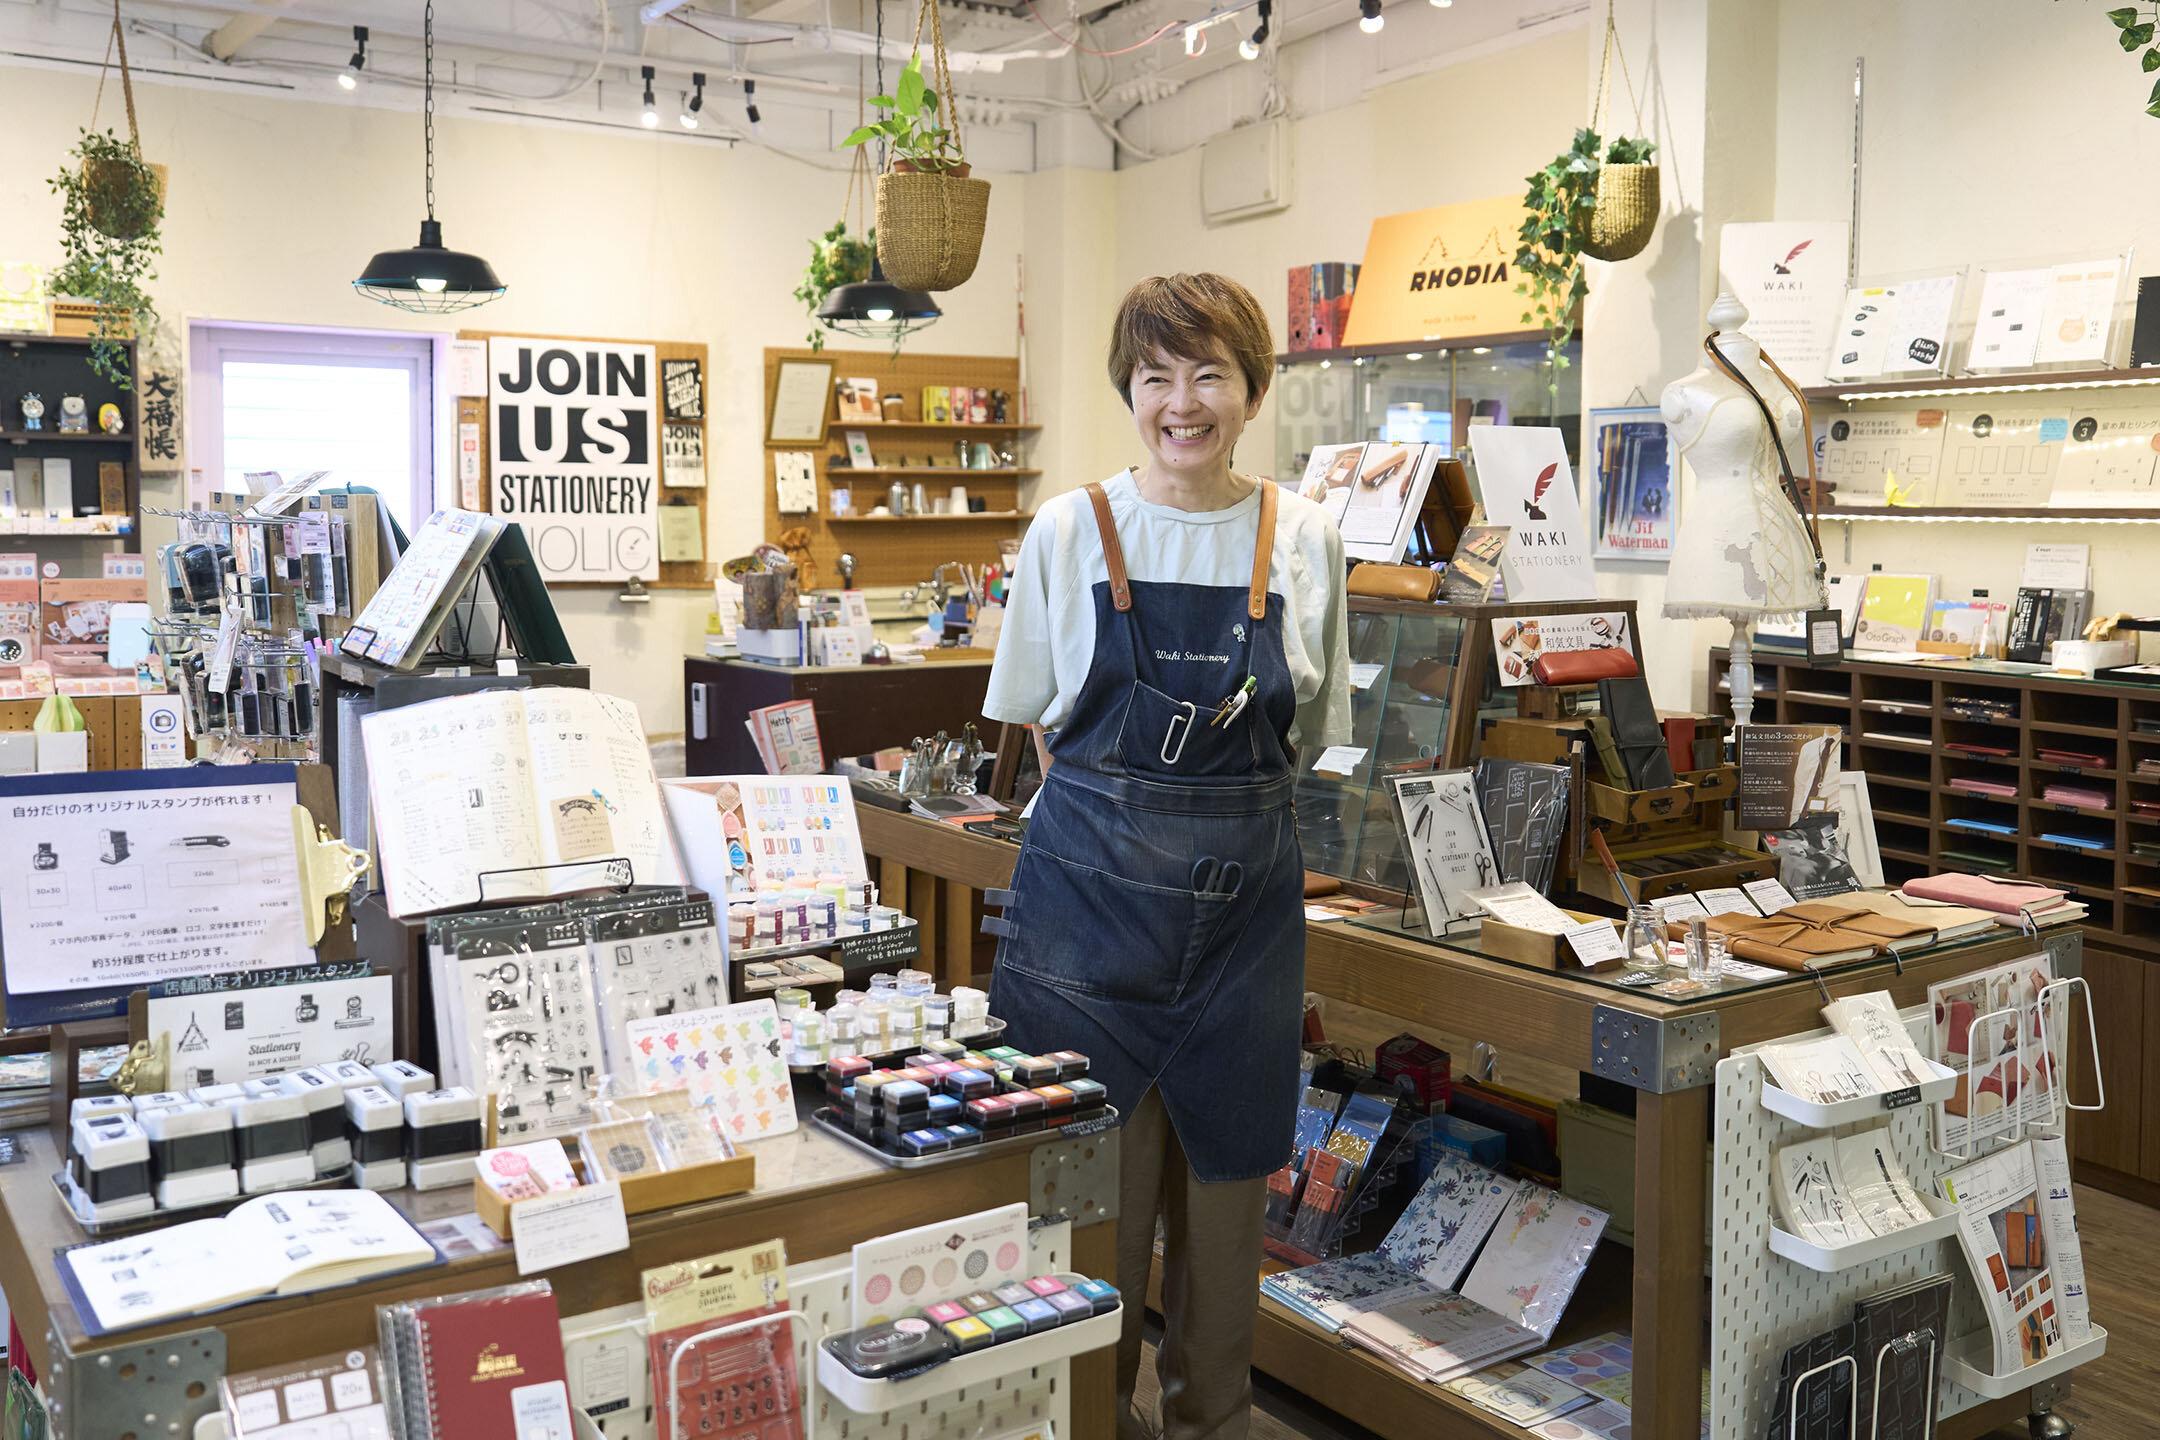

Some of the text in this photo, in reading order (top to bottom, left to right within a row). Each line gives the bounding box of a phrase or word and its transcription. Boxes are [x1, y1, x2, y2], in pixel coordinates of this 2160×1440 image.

[1410, 262, 1508, 291] RHODIA
[1763, 281, 1803, 290] WAKI
[498, 347, 647, 397] JOIN
[142, 371, 177, 460] 大福帳
[503, 404, 643, 464] US
[2080, 427, 2088, 437] 3
[500, 474, 650, 514] STATIONERY
[1635, 521, 1653, 534] Jif
[1519, 531, 1567, 546] WAKI
[1608, 534, 1668, 549] Waterman
[1512, 555, 1583, 567] STATIONERY
[1546, 635, 1585, 648] 和気文具
[1155, 650, 1230, 664] Waki Stationery
[13, 794, 273, 818] 自分だけのオリジナルスタンプが作れます！
[1445, 830, 1457, 838] JOIN
[1441, 852, 1470, 862] STATIONERY
[1451, 865, 1466, 873] HOLIC
[677, 905, 706, 914] CLEAR
[678, 912, 707, 921] STAMP
[163, 960, 371, 996] 店舗限定オリジナルスタンプ
[248, 1041, 302, 1056] Stationery
[257, 1058, 272, 1066] NOT
